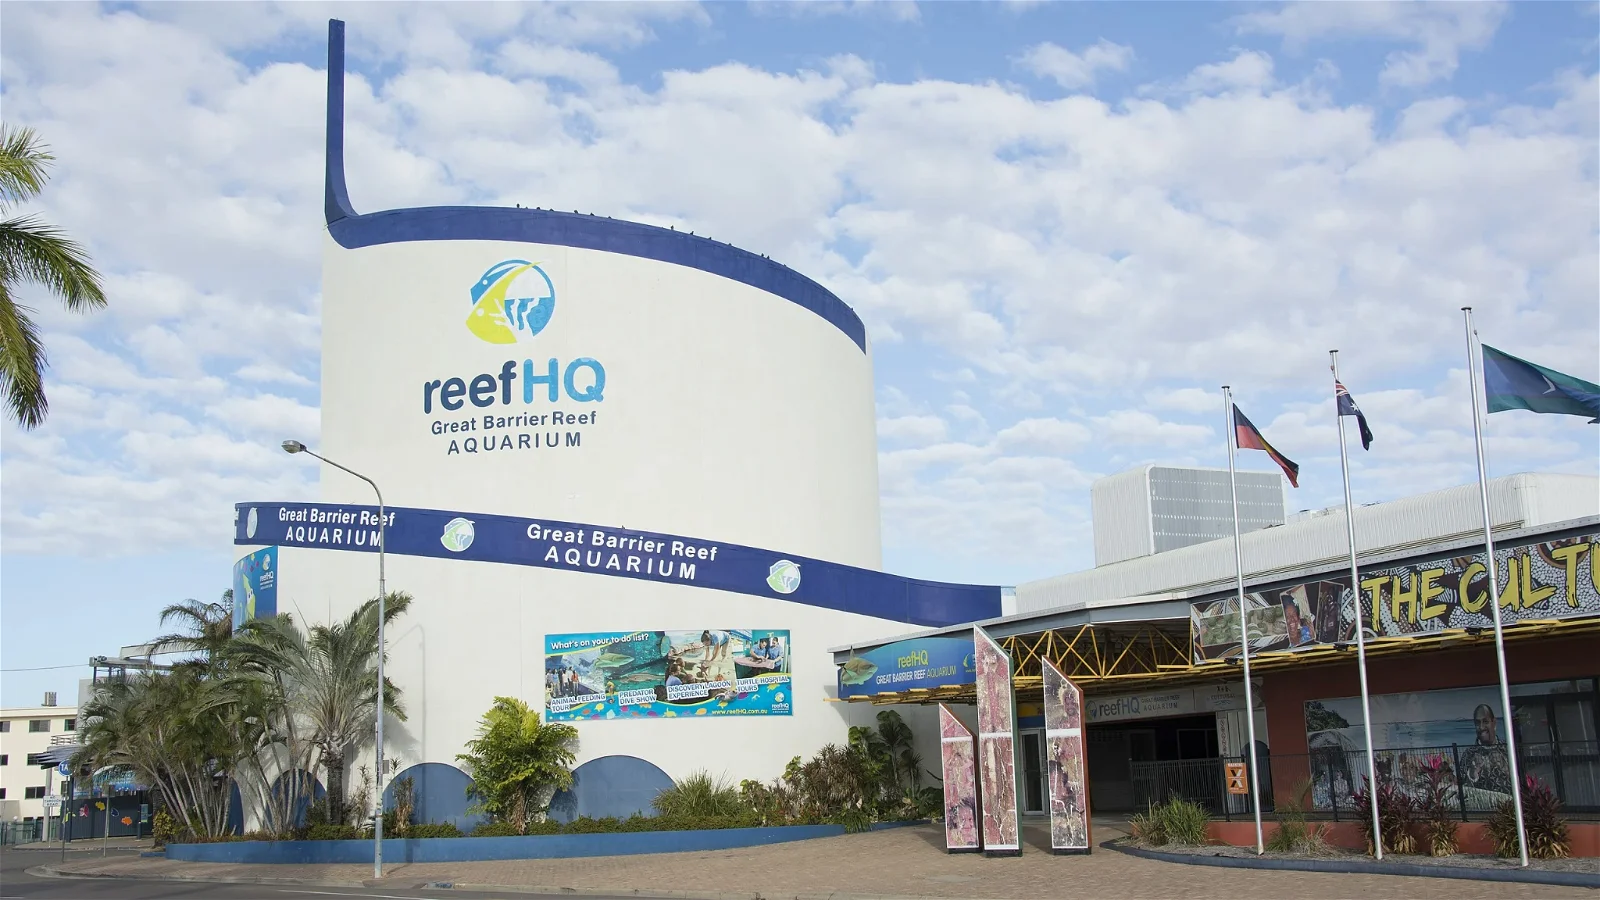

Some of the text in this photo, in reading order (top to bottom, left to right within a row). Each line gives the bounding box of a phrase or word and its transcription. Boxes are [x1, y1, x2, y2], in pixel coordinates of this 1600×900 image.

[423, 357, 606, 415] reefHQ
[431, 410, 597, 435] Great Barrier Reef
[447, 432, 581, 455] AQUARIUM
[278, 507, 395, 527] Great Barrier Reef
[286, 526, 381, 547] AQUARIUM
[526, 523, 718, 562] Great Barrier Reef
[544, 545, 697, 580] AQUARIUM
[1361, 567, 1448, 632] THE
[551, 633, 649, 650] What's on your to do list?
[897, 650, 929, 669] reefHQ
[760, 675, 789, 684] HOSPITAL
[876, 674, 892, 685] GREAT
[892, 671, 913, 683] BARRIER
[913, 669, 926, 680] REEF
[927, 665, 957, 679] AQUARIUM
[619, 688, 654, 698] PREDATOR
[668, 680, 731, 693] DISCOVERY LAGOON
[668, 690, 708, 699] EXPERIENCE
[552, 693, 606, 706] ANIMAL FEEDING
[620, 695, 656, 705] DIVE SHOW
[1099, 696, 1141, 717] reefHQ
[1143, 702, 1178, 712] AQUARIUM
